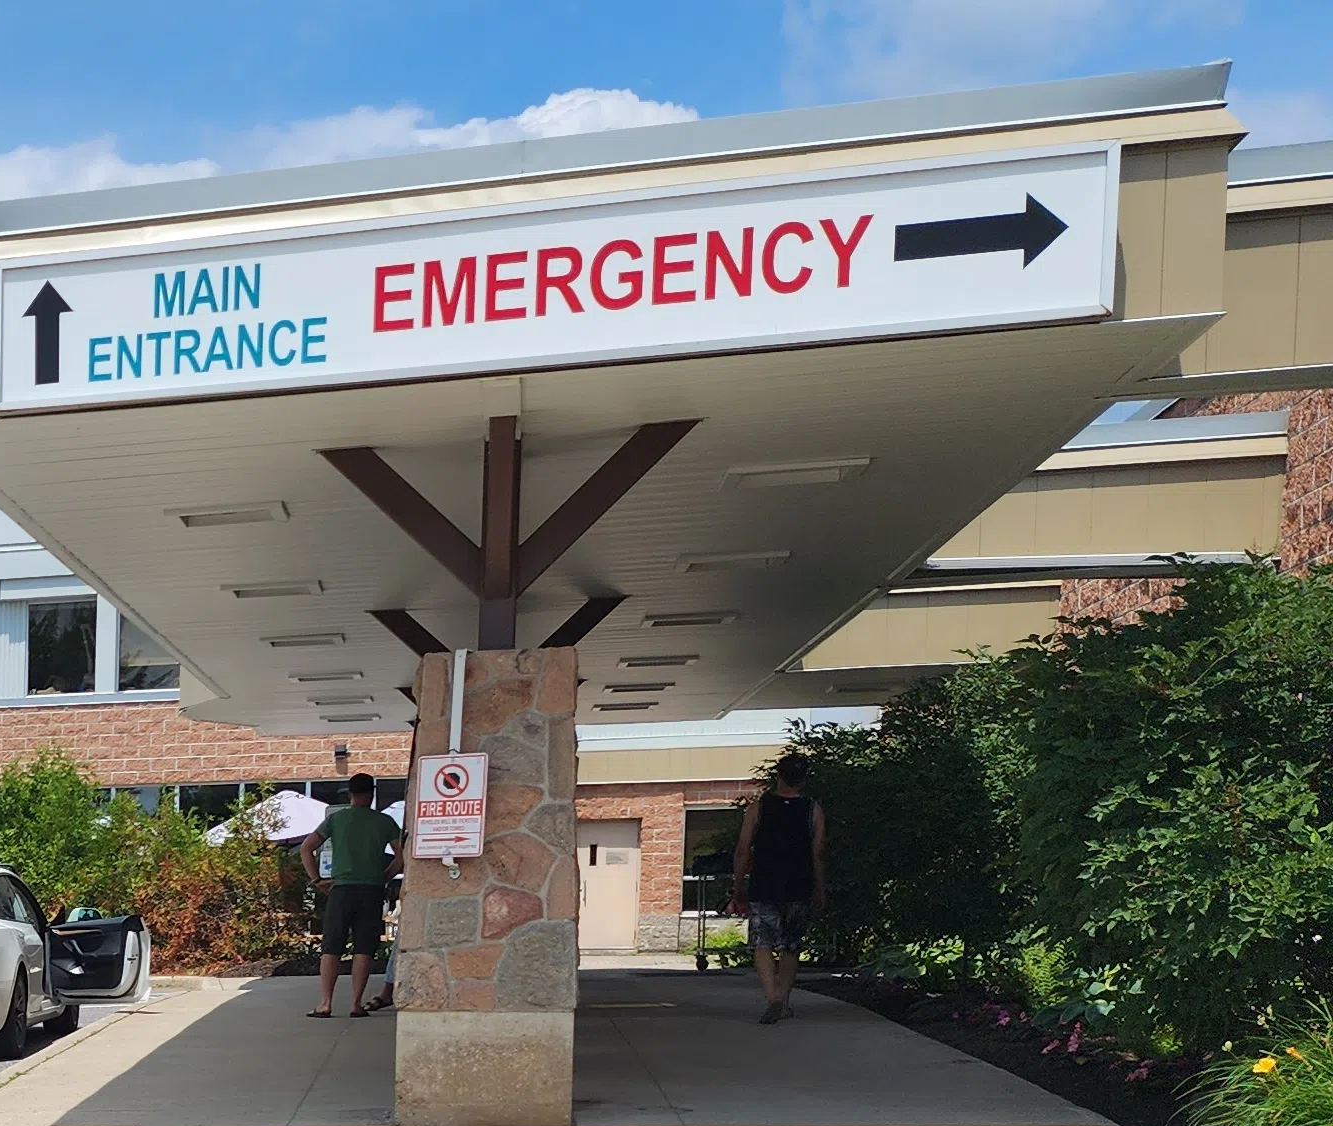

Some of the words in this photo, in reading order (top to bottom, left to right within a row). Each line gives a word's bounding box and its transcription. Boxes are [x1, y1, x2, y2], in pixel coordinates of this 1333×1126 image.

[153, 263, 261, 319] MAIN
[373, 214, 875, 333] EMERGENCY
[88, 317, 328, 383] ENTRANCE
[419, 801, 444, 817] FIRE
[445, 799, 482, 816] ROUTE
